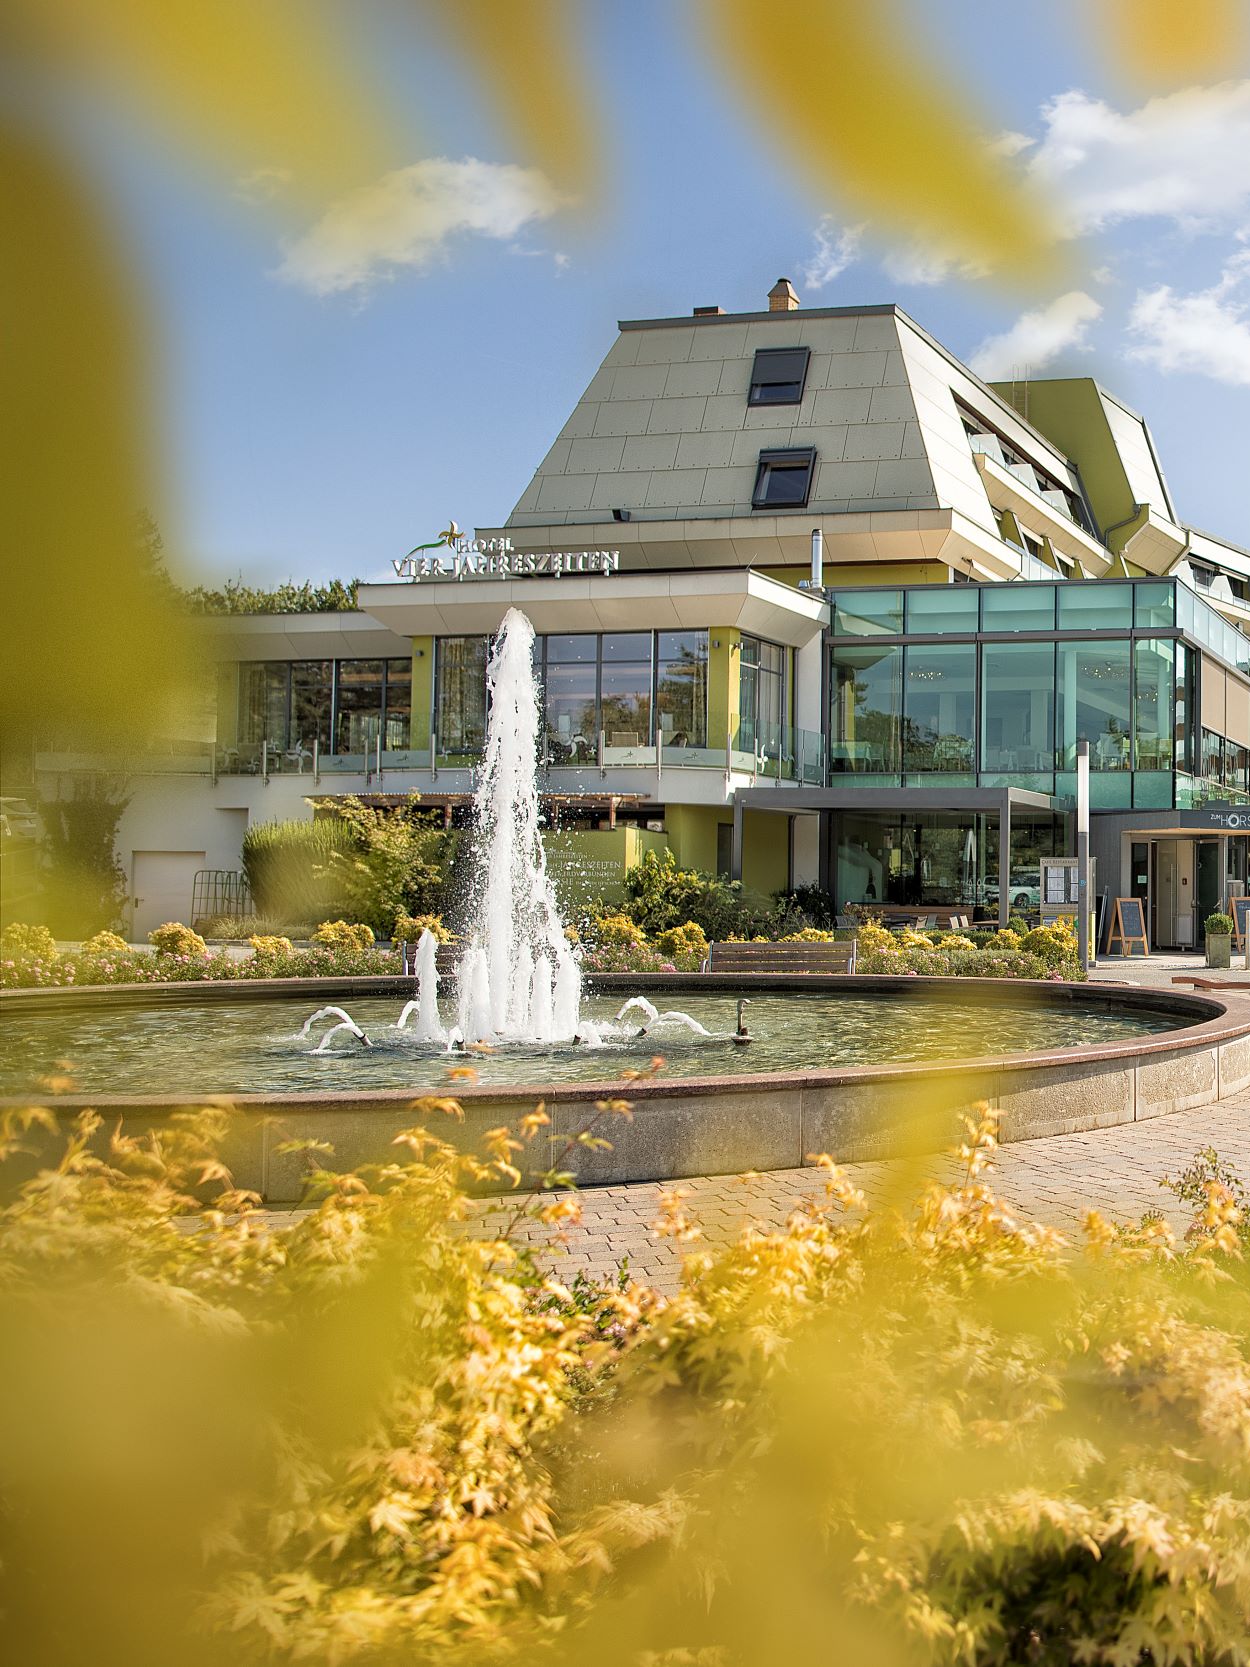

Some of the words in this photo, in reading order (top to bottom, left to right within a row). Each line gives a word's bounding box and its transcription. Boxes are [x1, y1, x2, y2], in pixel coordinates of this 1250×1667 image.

[457, 537, 515, 553] HOTEL
[390, 558, 448, 577] VIER
[450, 551, 620, 580] JAHRESZEITEN
